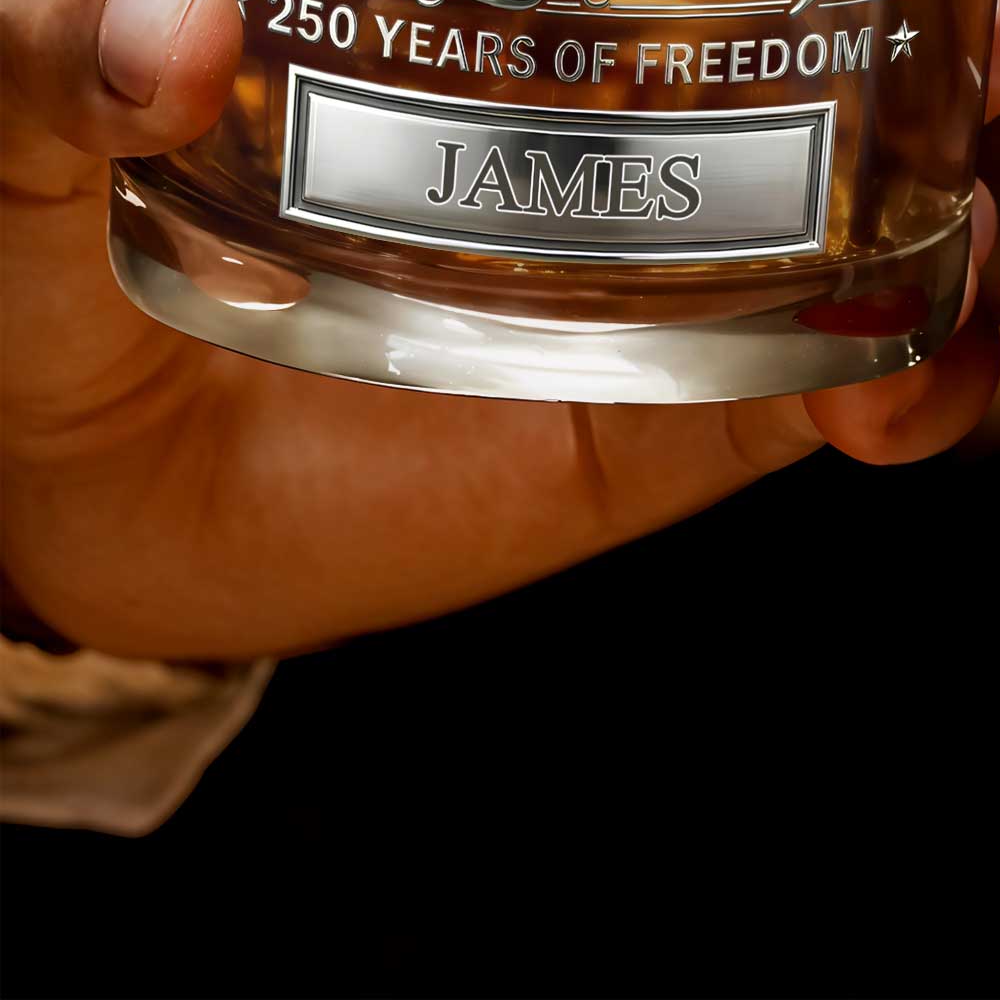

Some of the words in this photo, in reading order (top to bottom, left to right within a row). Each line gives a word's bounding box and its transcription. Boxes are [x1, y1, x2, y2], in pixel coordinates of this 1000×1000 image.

[375, 14, 536, 80] YEARS
[554, 39, 618, 84] OF
[637, 26, 875, 85] FREEDOM
[426, 139, 702, 221] JAMES
